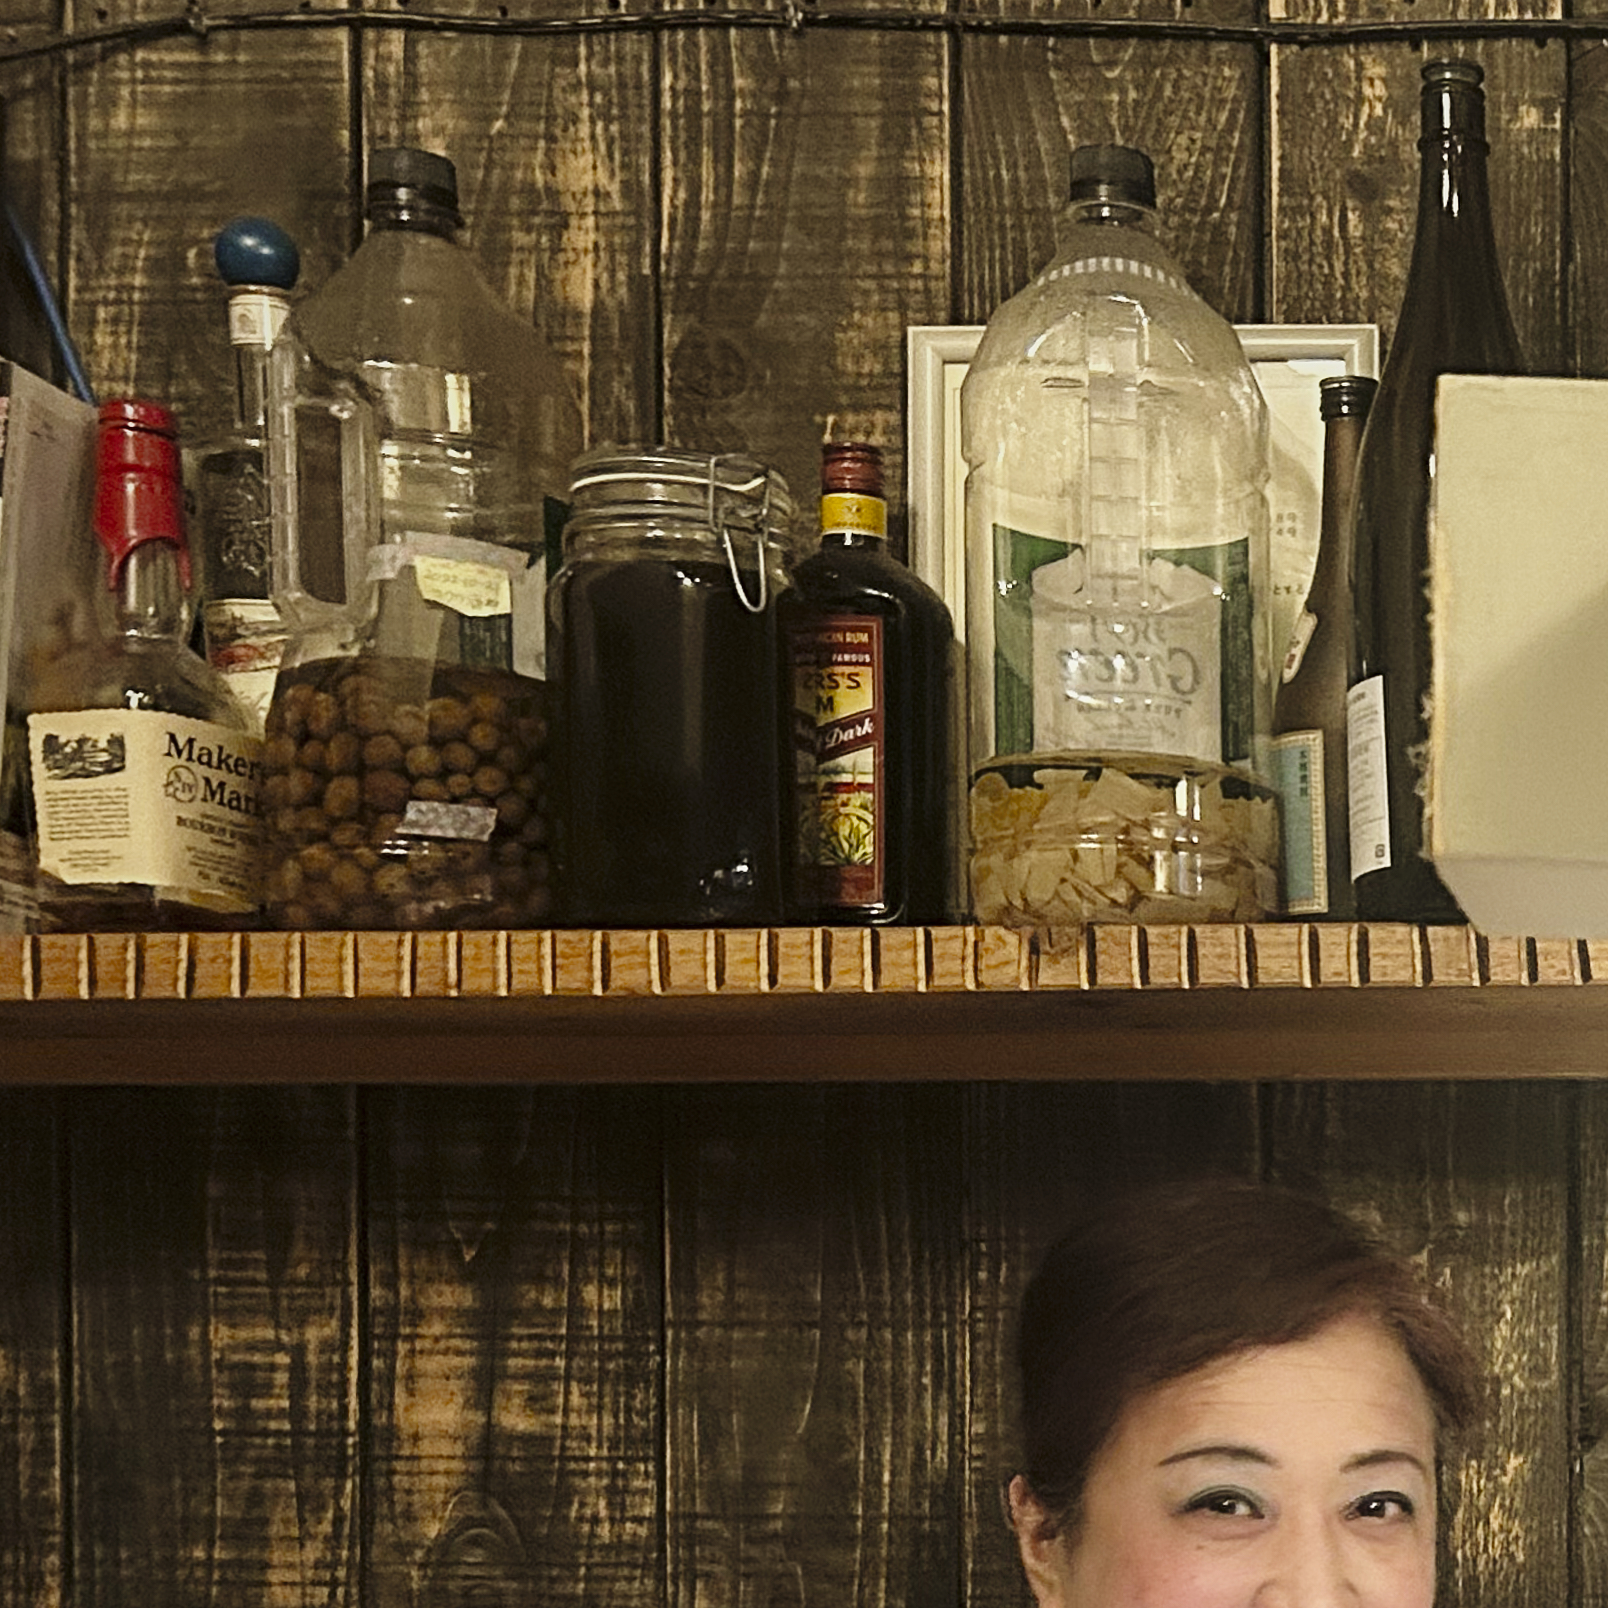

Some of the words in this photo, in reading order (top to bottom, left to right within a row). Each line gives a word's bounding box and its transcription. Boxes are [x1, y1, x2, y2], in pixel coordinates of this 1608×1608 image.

[830, 652, 871, 663] FAMOUS
[825, 717, 875, 750] Dark
[163, 731, 263, 780] Maker
